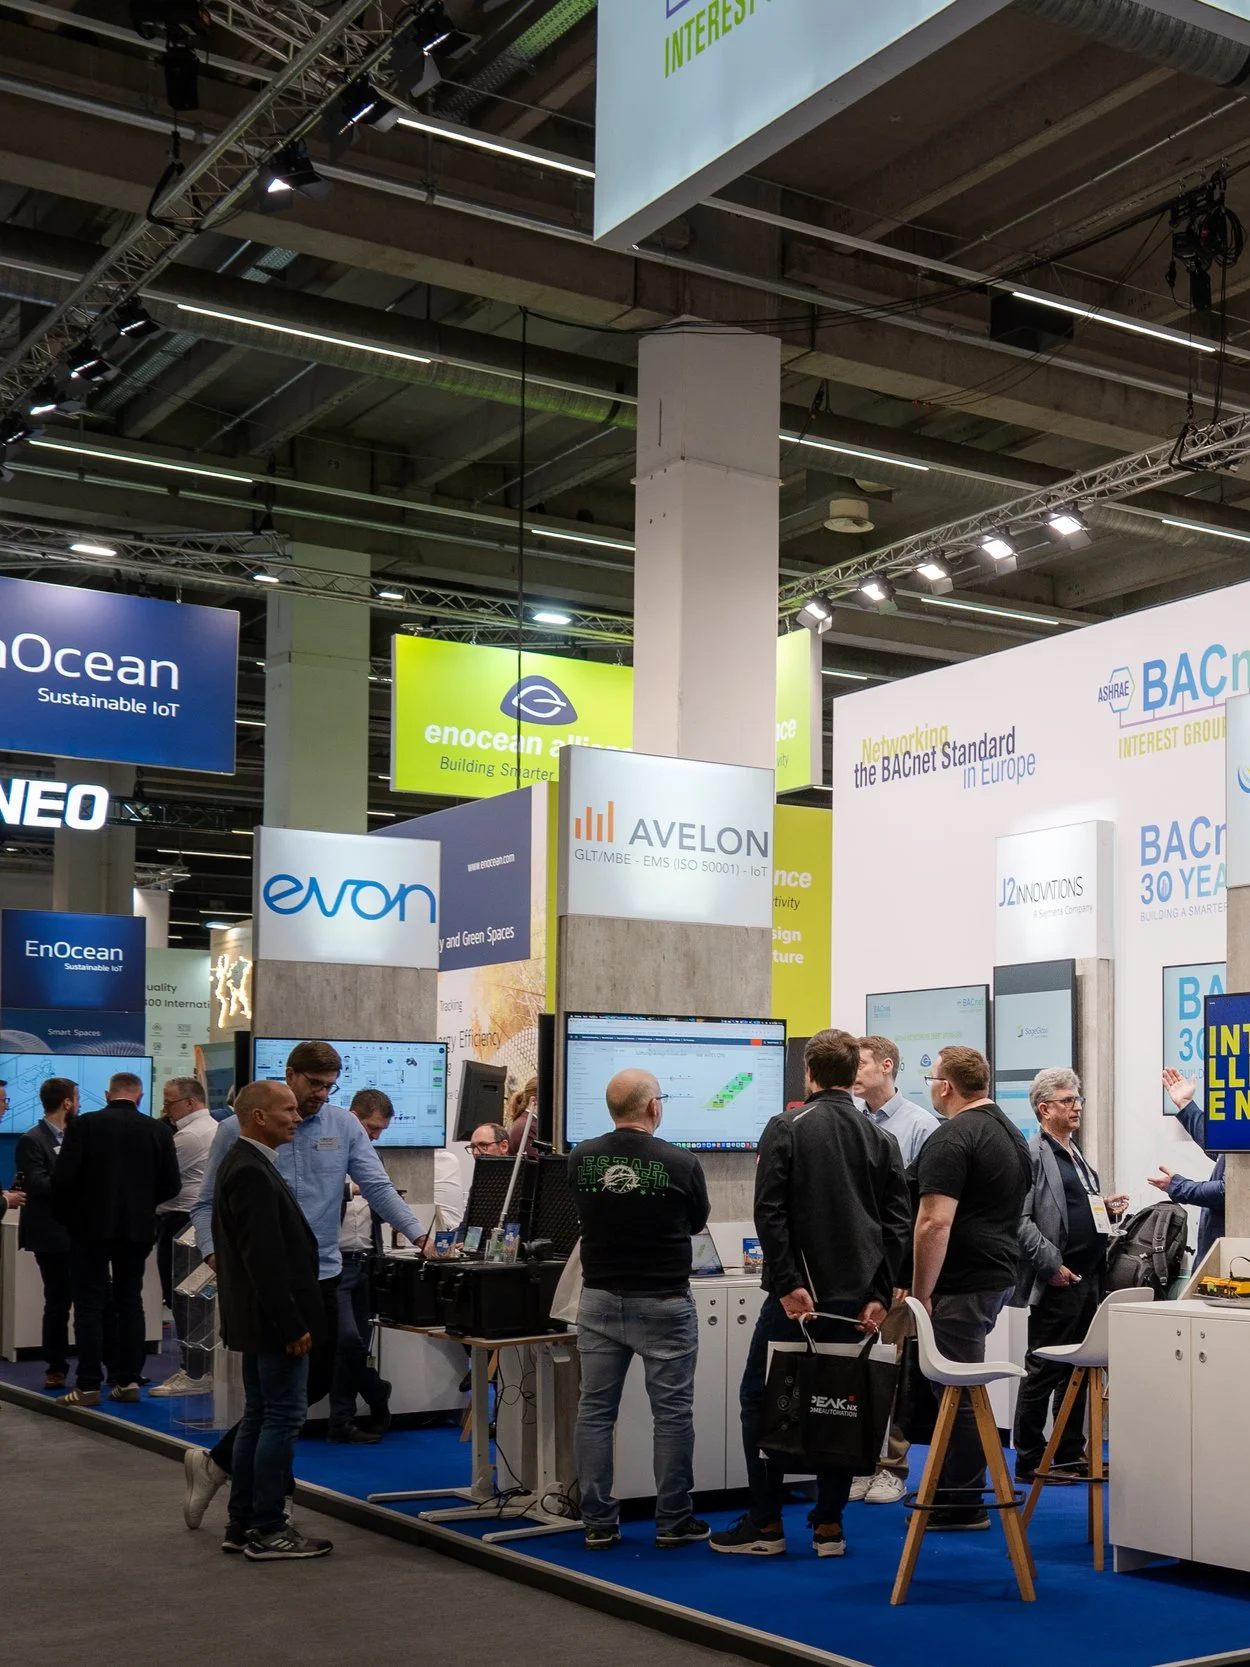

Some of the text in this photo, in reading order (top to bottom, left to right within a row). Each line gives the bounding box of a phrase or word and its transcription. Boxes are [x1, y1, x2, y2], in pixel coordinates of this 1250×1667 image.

[0, 632, 180, 691] Ocean
[37, 687, 181, 717] Sustainable IoT
[1098, 680, 1130, 704] ASHRAE
[425, 721, 543, 757] enocean
[862, 723, 949, 766] Networking
[1118, 726, 1179, 760] INTEREST
[440, 756, 555, 781] Building Smarter
[854, 726, 1016, 789] the BACnet Standard
[962, 752, 1036, 789] in Europe
[629, 818, 769, 858] AVELON
[467, 852, 516, 873] www.enocean.com
[574, 848, 631, 865] GLT/MBE
[643, 855, 670, 869] EMS
[673, 857, 698, 871] (ISO
[702, 861, 740, 876] 50001)
[751, 866, 769, 877] IoT
[263, 874, 437, 923] evon
[1141, 870, 1173, 905] 30
[1065, 903, 1093, 917] Company
[1140, 907, 1179, 922] BUILDING
[1181, 908, 1187, 917] A
[25, 940, 124, 961] EnOcean
[446, 934, 460, 949] and
[463, 930, 485, 946] Green
[486, 926, 515, 946] Spaces
[64, 962, 110, 972] Sustainable
[73, 1029, 101, 1037] Spaces
[459, 1028, 501, 1050] Efficiency
[847, 1404, 858, 1412] NX
